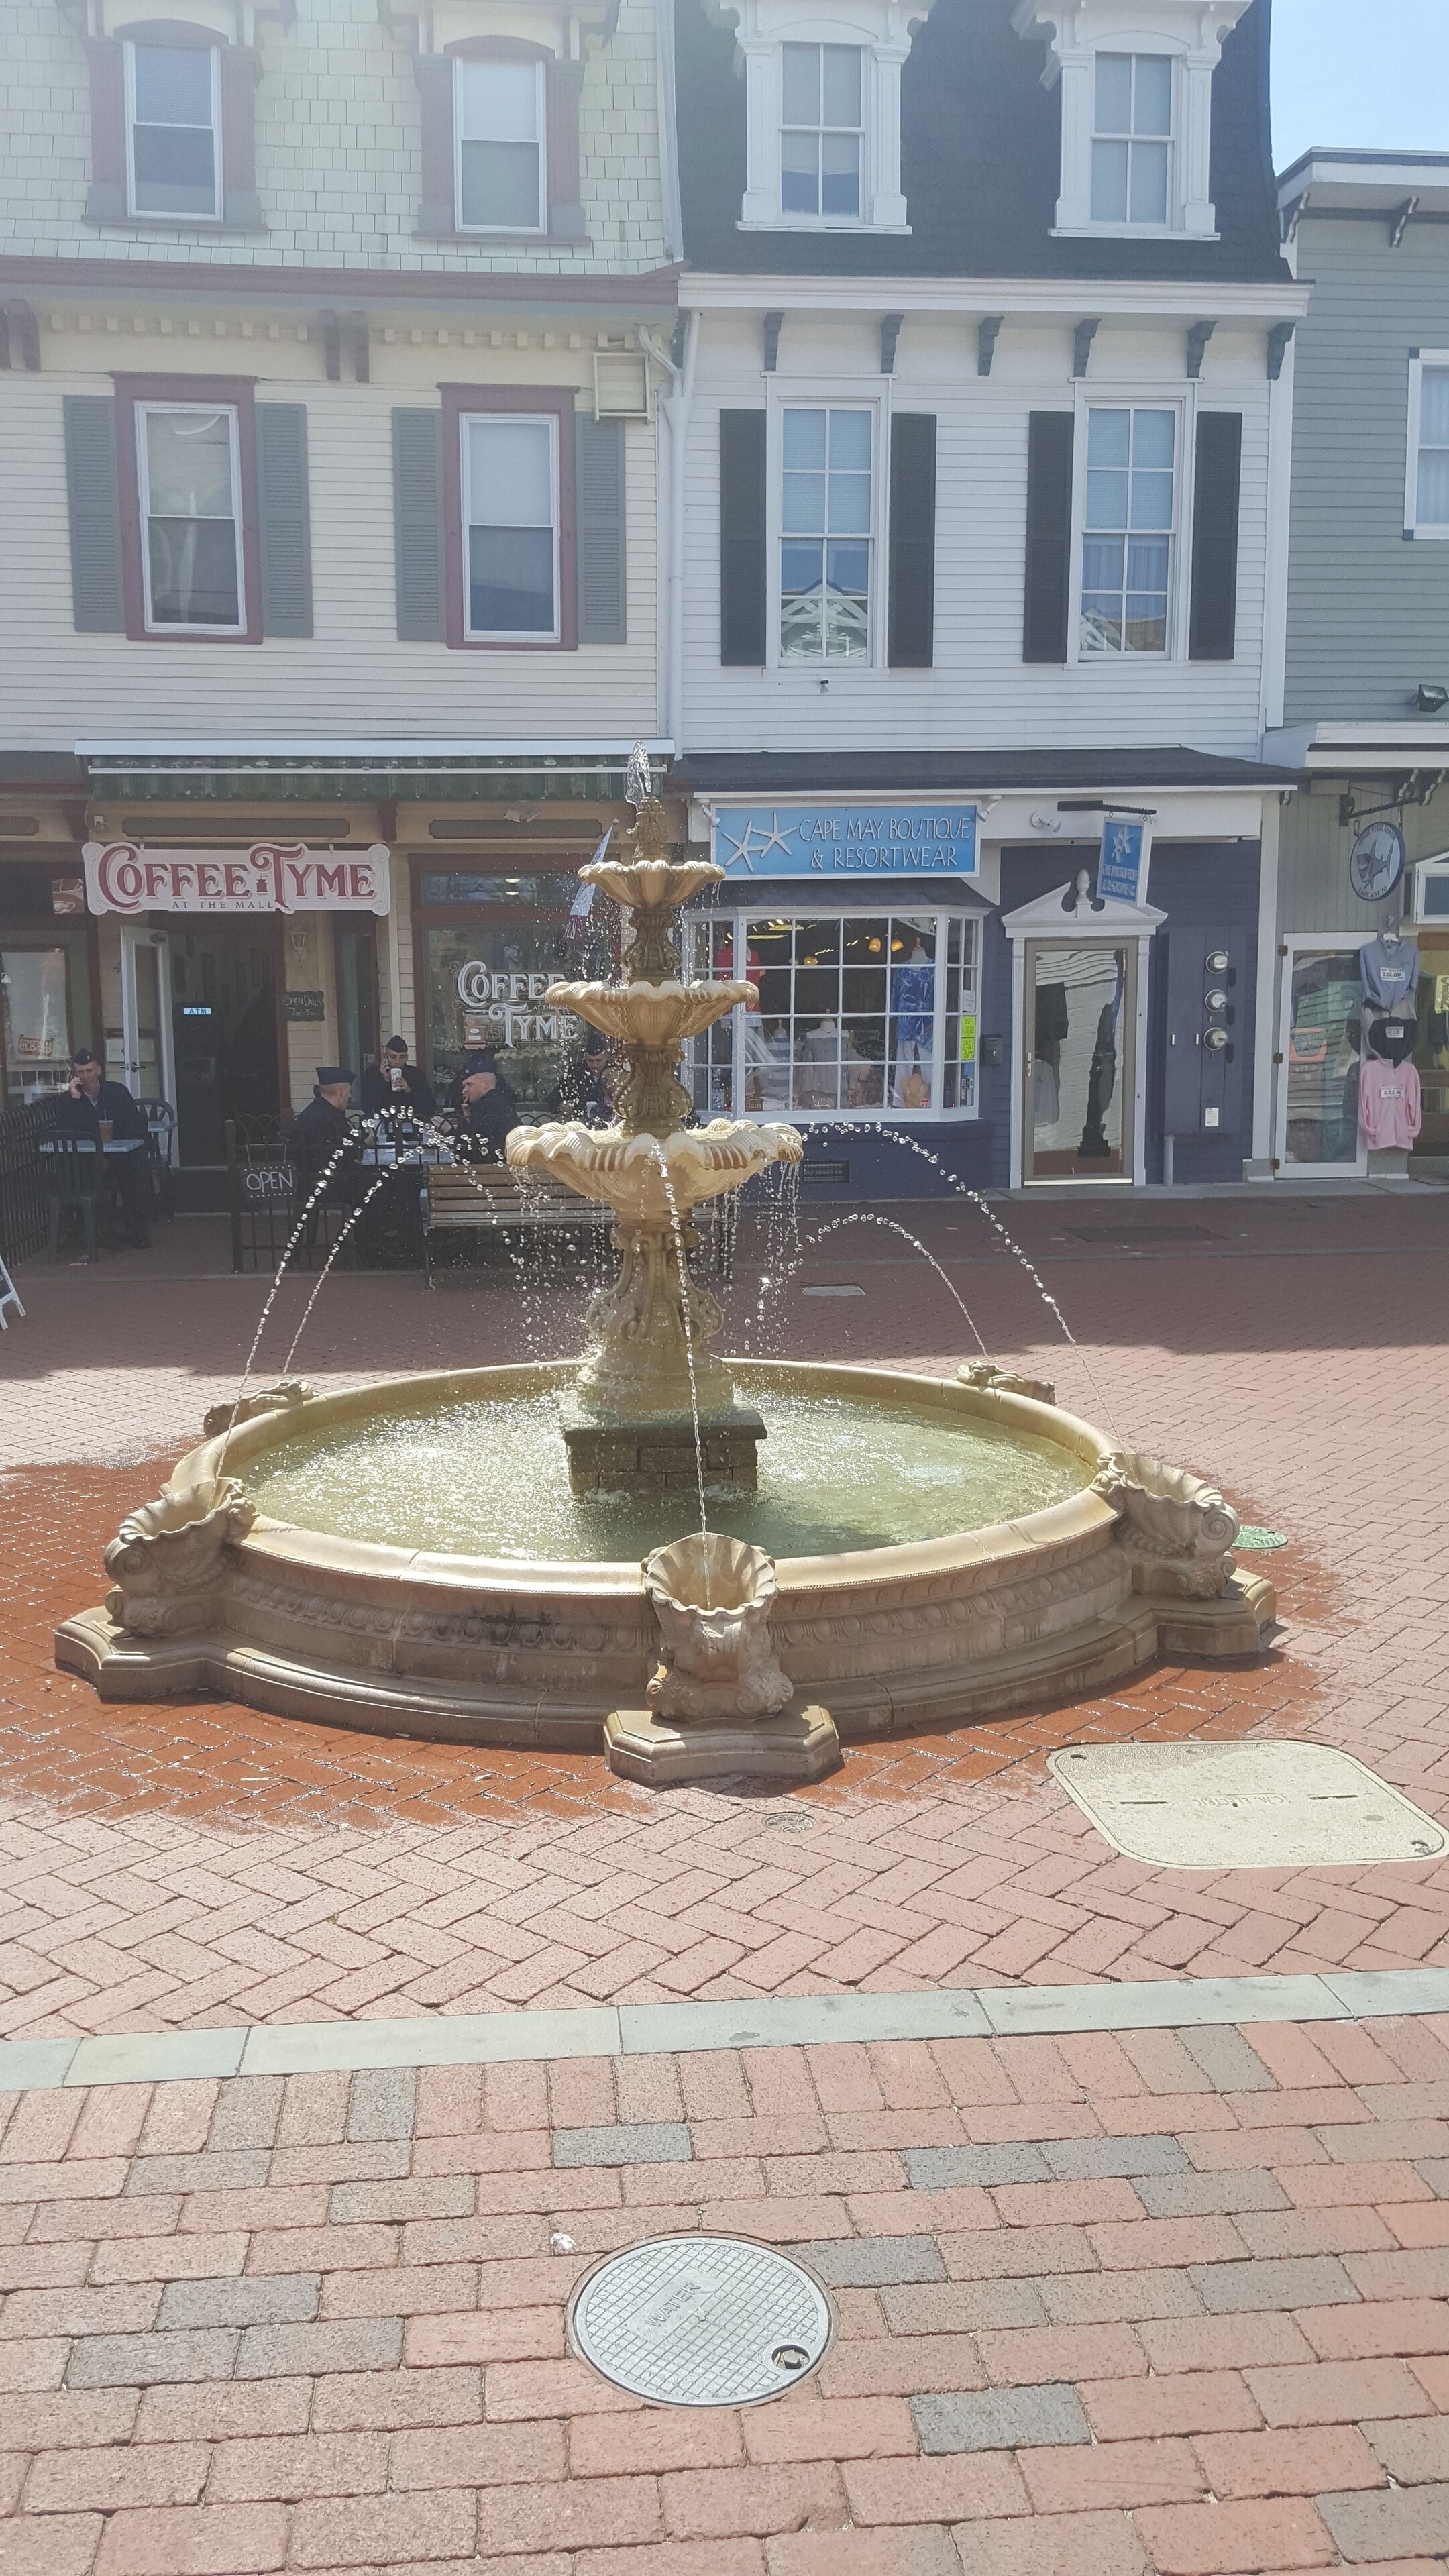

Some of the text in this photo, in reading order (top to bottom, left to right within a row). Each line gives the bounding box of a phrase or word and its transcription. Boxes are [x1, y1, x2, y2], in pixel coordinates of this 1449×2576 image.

[798, 817, 971, 841] CAPE MAY BOUTIQUE
[811, 846, 958, 870] & RESORTWEAR
[98, 845, 376, 908] COFFEE TYME
[172, 900, 274, 909] AT THE MALL
[282, 994, 323, 1006] OPEN DAILY
[488, 1002, 580, 1049] TYME
[246, 1168, 293, 1193] OPEN
[1191, 1796, 1252, 1807] ELECTRIC
[645, 2281, 702, 2328] WATER
